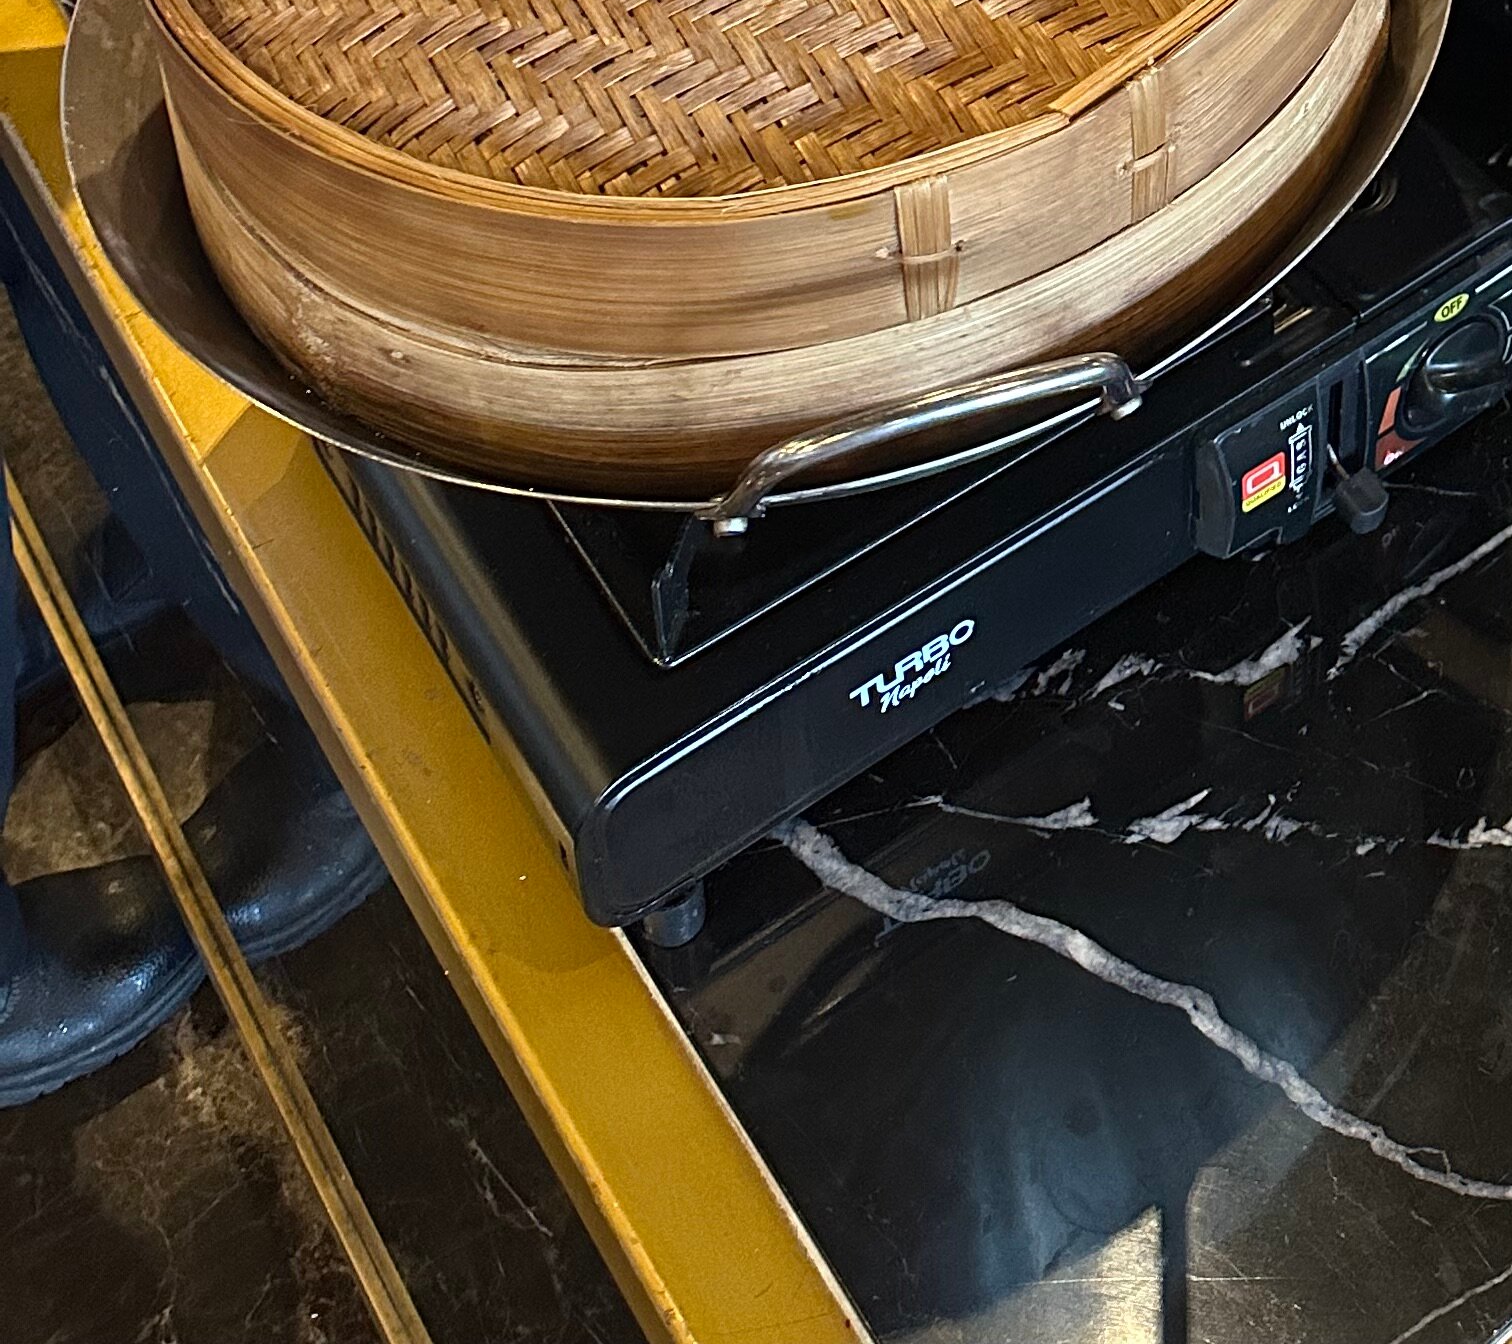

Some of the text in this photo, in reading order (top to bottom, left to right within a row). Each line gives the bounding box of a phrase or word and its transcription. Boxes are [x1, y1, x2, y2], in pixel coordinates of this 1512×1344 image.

[1440, 295, 1463, 319] OFF
[1280, 403, 1314, 431] UNLOCK
[1295, 438, 1307, 474] GAS
[849, 619, 975, 708] TURBO
[880, 653, 952, 714] Napoli
